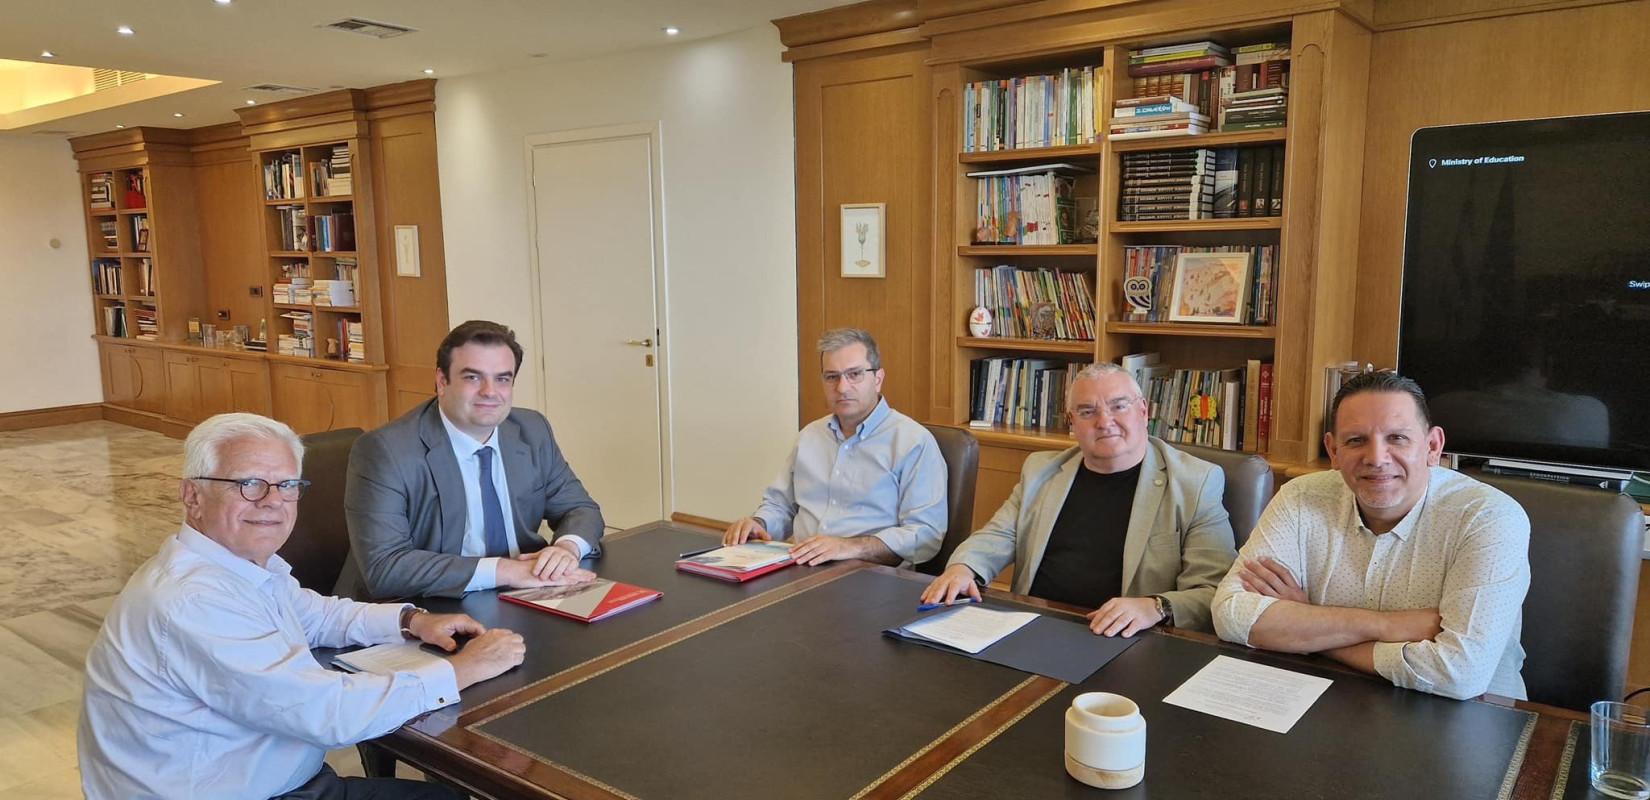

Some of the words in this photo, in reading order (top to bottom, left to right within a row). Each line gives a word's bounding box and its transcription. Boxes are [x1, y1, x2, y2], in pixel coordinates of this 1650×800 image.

[1441, 158, 1473, 166] Ministry
[1484, 155, 1525, 163] Education
[1629, 280, 1650, 289] Swip
